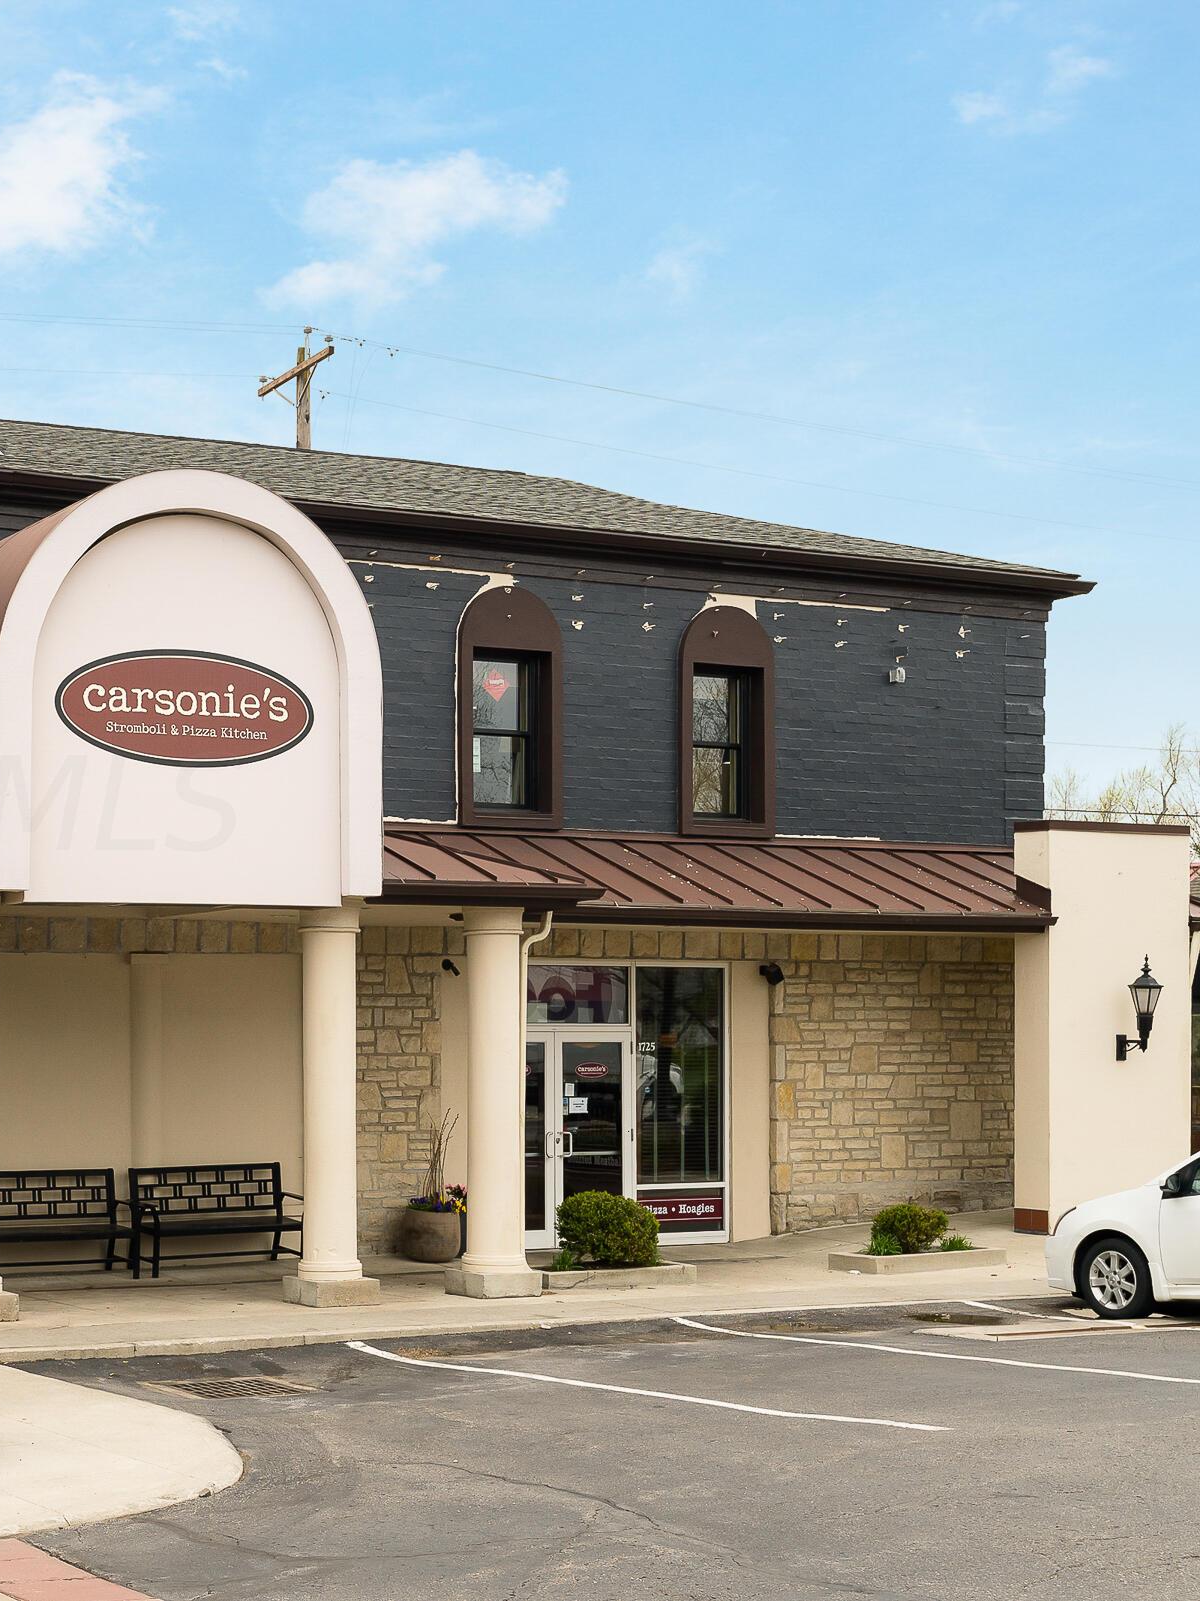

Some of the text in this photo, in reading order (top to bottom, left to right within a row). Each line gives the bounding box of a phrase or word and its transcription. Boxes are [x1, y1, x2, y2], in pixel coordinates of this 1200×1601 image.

[82, 683, 289, 722] carsonie's
[106, 721, 267, 740] Stromboli & Pizza Kitchen
[638, 1042, 655, 1051] 1725
[678, 1203, 715, 1215] Hoagies
